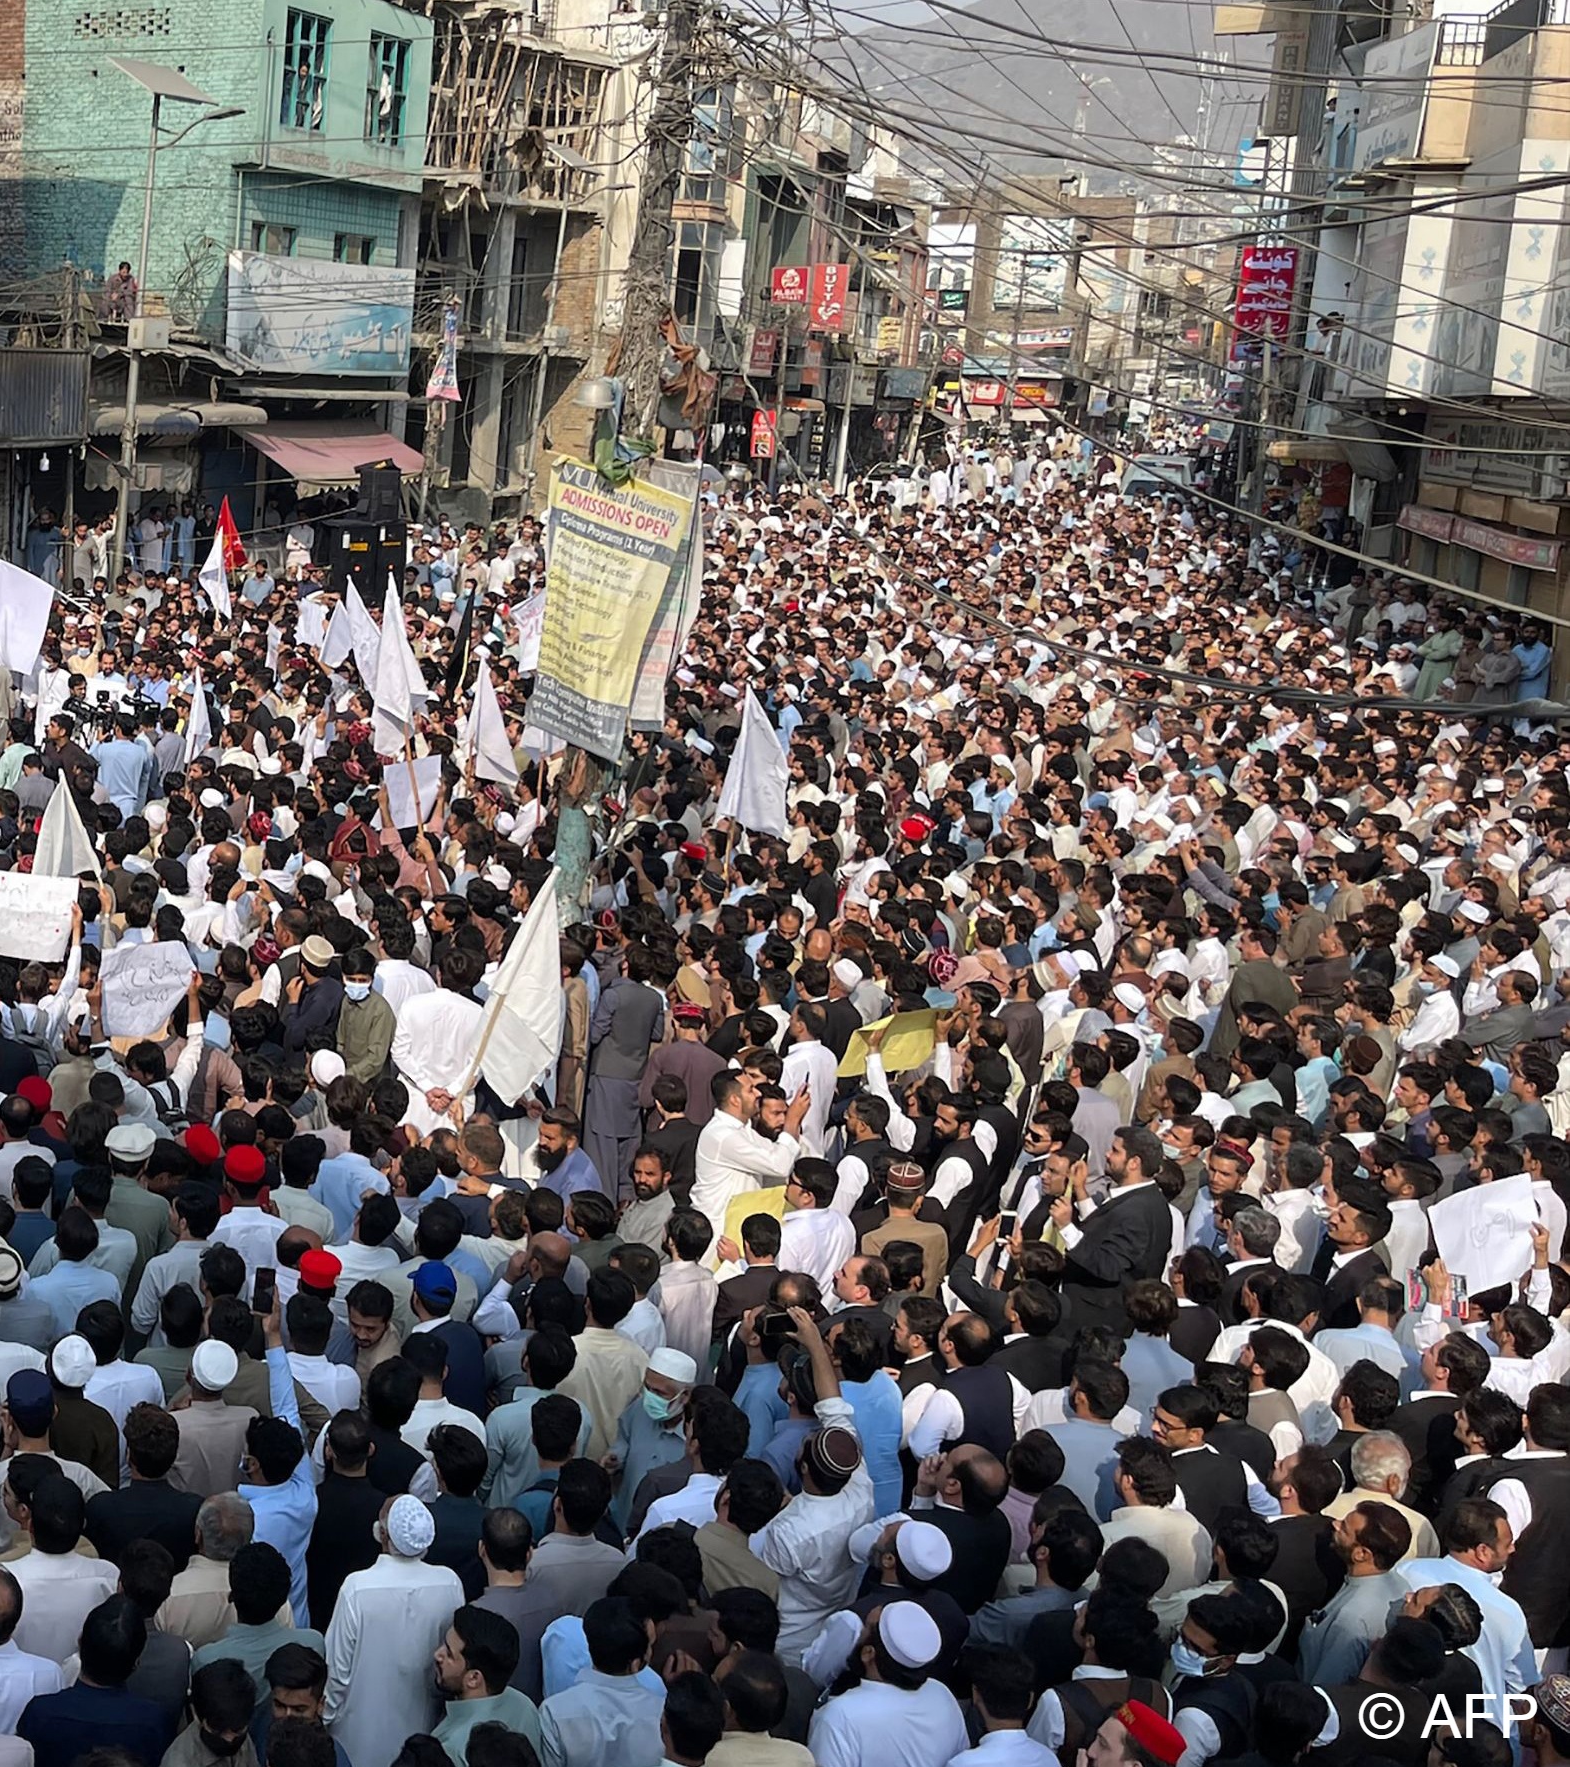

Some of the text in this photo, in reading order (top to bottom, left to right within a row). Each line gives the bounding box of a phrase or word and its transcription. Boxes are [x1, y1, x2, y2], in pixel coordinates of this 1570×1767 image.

[1243, 250, 1295, 273] کوئٹہ
[824, 266, 837, 301] BUTT
[560, 488, 671, 539] ADMISSIONS OPEN
[630, 492, 680, 527] University
[586, 523, 624, 547] Programs
[633, 537, 656, 557] Year)
